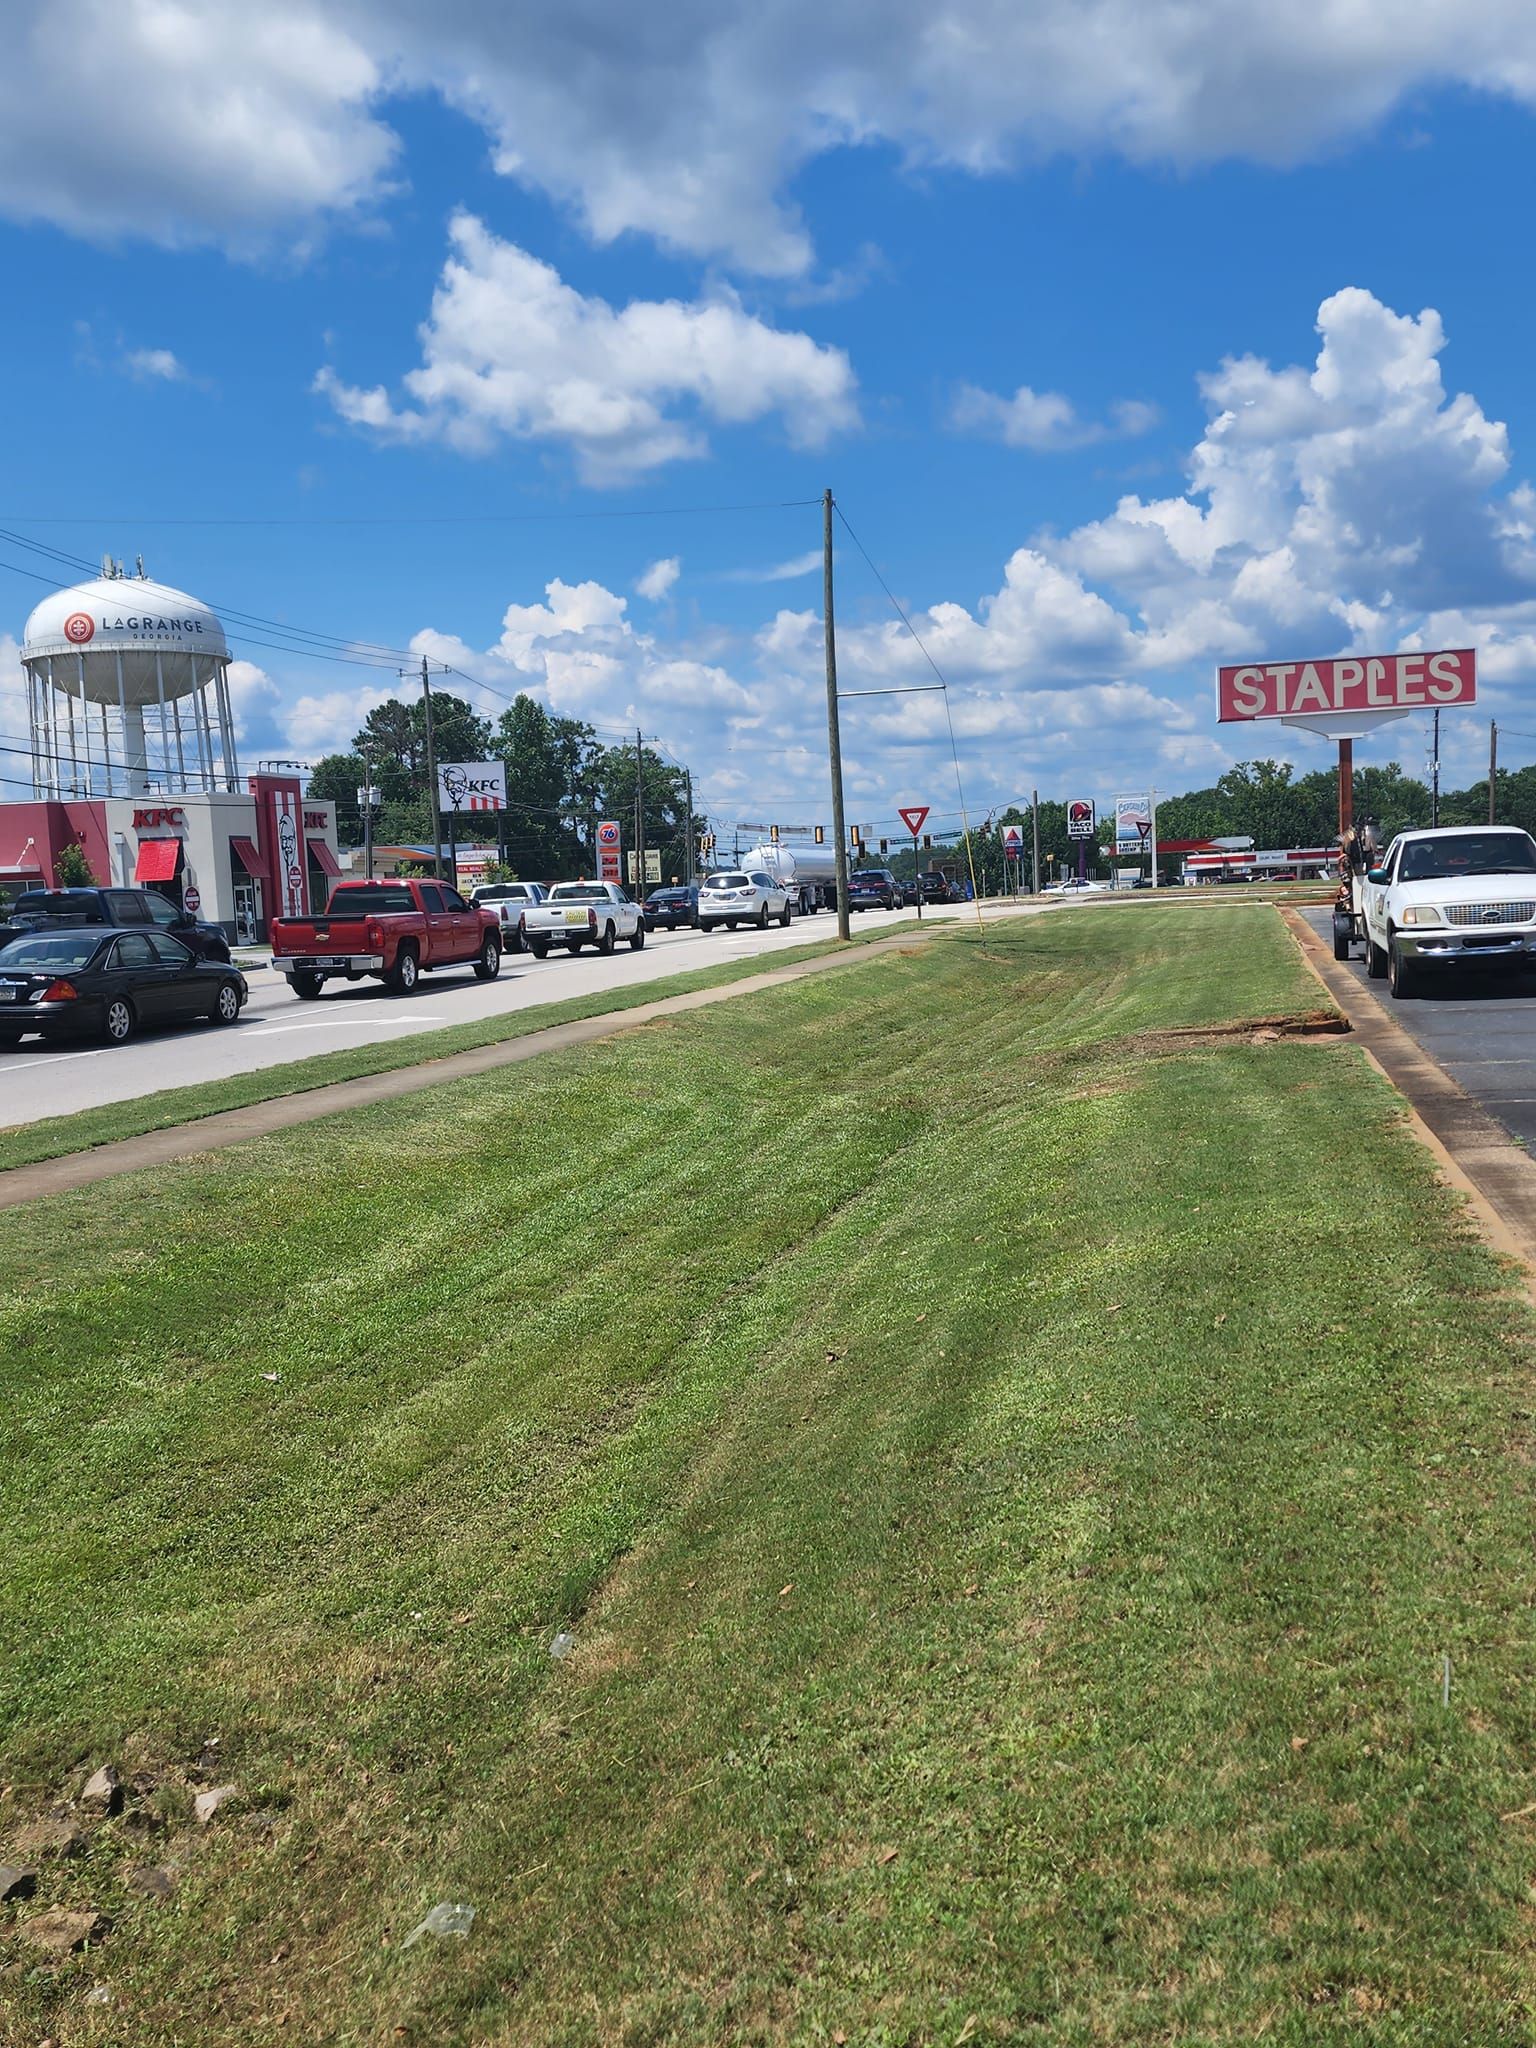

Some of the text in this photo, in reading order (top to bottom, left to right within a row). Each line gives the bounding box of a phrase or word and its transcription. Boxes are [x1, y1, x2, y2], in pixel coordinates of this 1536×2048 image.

[132, 633, 183, 641] GEORGIA
[1232, 653, 1463, 716] STAPLES
[468, 778, 500, 792] KFC
[131, 807, 184, 828] KFC
[304, 811, 328, 829] KFC
[602, 829, 615, 839] 76
